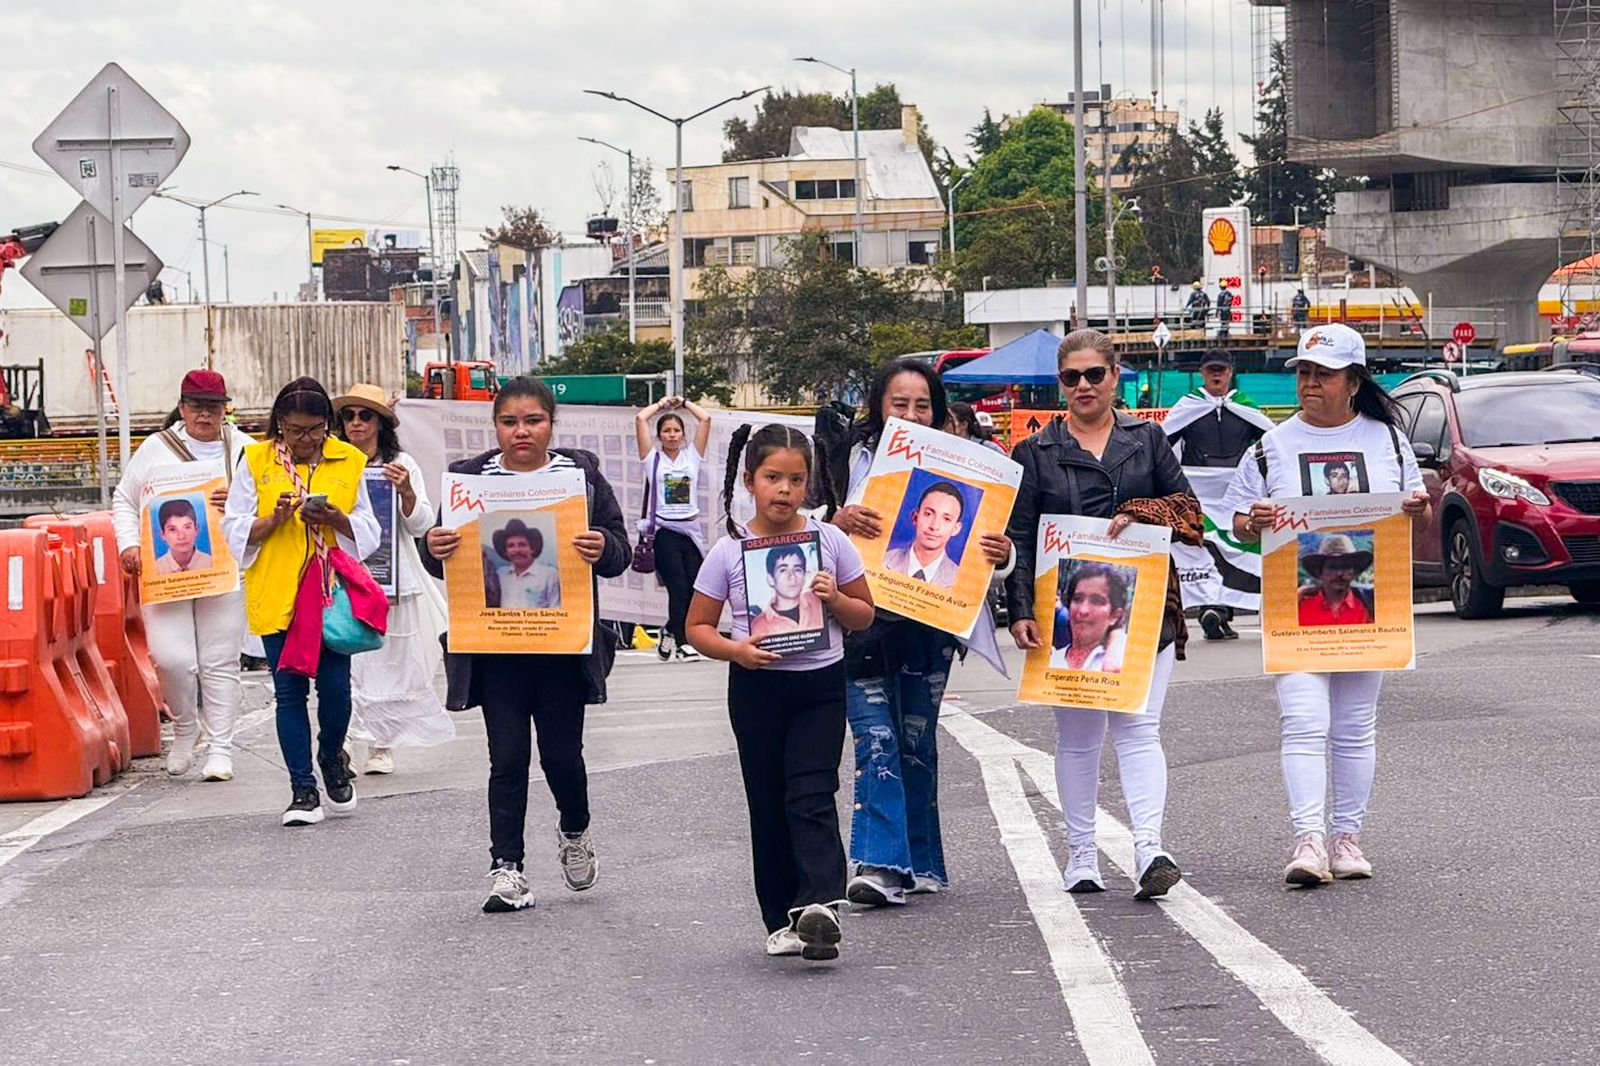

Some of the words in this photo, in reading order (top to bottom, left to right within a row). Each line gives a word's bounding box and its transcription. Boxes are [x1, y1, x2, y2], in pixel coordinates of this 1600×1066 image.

[1454, 328, 1473, 337] PARE
[925, 444, 967, 464] Familiares
[968, 457, 1004, 479] Colombia
[484, 489, 526, 498] Familiares
[528, 487, 567, 497] Colombia
[1308, 506, 1351, 517] Familiares
[1353, 505, 1393, 515] Colombia
[746, 532, 812, 549] DESAPARECIDO
[878, 573, 915, 592] Segundo
[916, 586, 945, 602] Franco
[497, 610, 521, 618] Santos
[1271, 629, 1301, 637] Gustavo
[1302, 628, 1337, 636] Humberto
[1338, 627, 1376, 635] Salamanca
[1378, 626, 1407, 634] Bautista
